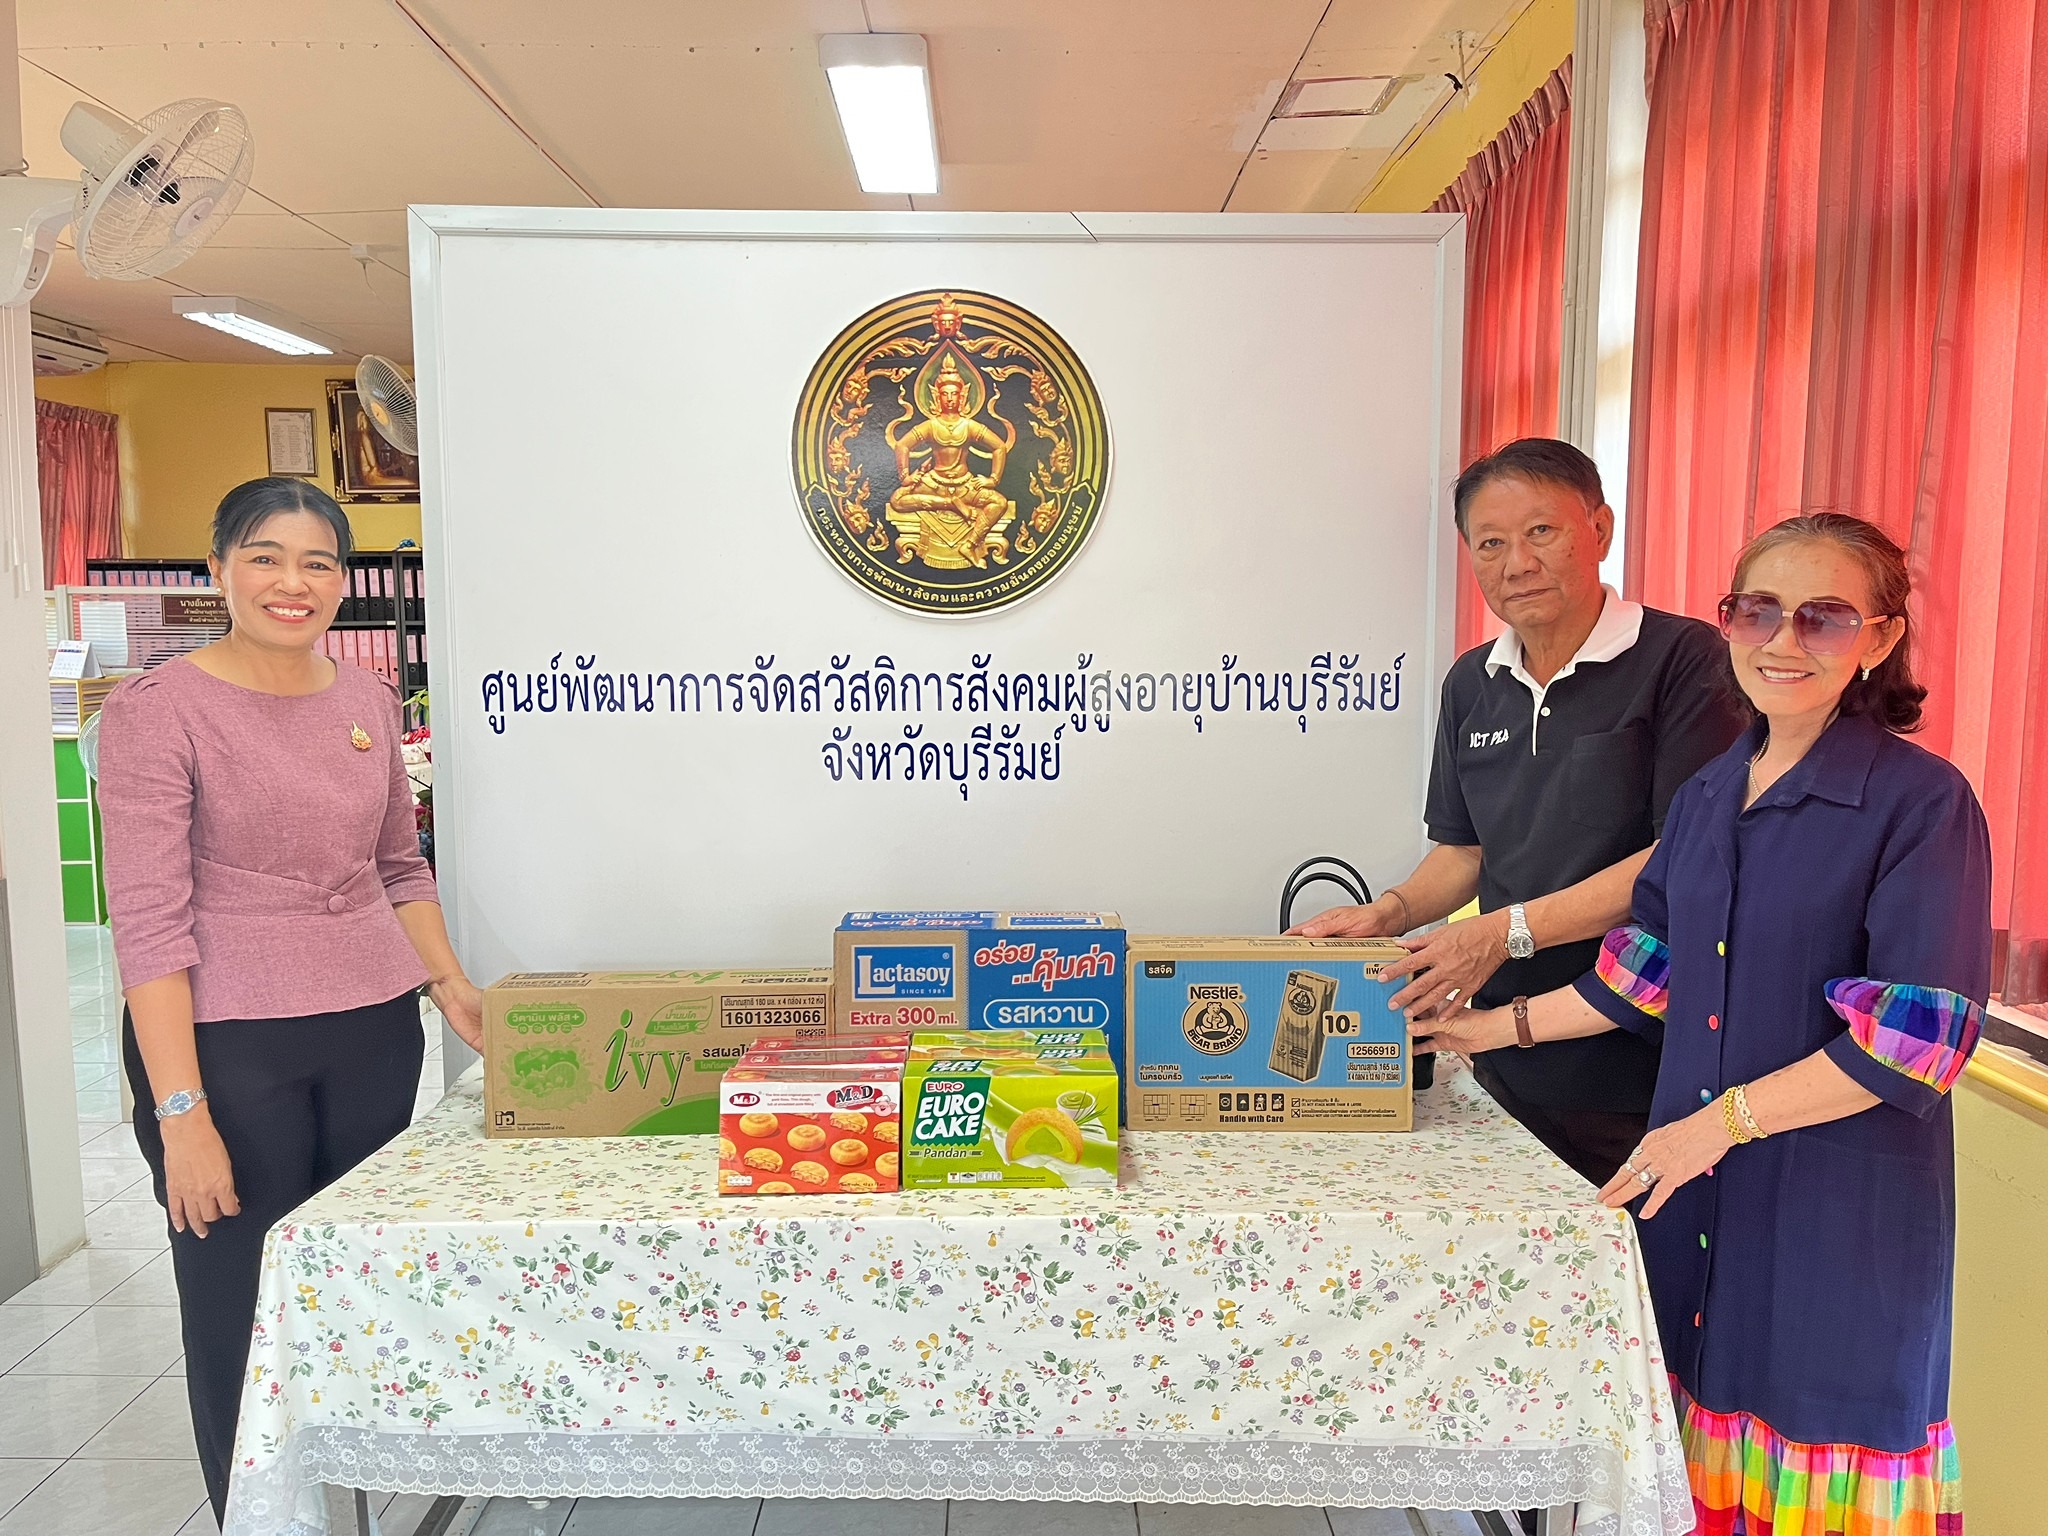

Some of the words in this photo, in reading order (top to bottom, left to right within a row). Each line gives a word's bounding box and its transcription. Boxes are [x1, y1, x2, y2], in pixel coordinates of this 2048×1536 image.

[481, 652, 1406, 735] ศูนย์พัฒนาการจัดสวัสดิการสังคมผู้สูงอายุบ้านบุรีรัมย์
[1469, 732, 1490, 748] ICT
[821, 723, 1066, 801] จังหวัดบุรีรัมย์
[974, 939, 1036, 967] อร่อย
[857, 954, 951, 995] Lactasoy
[1148, 964, 1173, 974] รสจืด
[1366, 963, 1385, 975] แพ็
[808, 997, 815, 1005] 12
[512, 1013, 546, 1022] วิตามิน
[725, 1010, 821, 1025] 1601323066
[850, 1012, 891, 1026] Extra
[897, 1007, 936, 1025] 300
[938, 1011, 958, 1026] ml.
[998, 1004, 1094, 1024] รสหวาน
[1187, 1028, 1211, 1050] BEAR
[1213, 1027, 1243, 1050] BRAND
[603, 1009, 690, 1107] ivy
[1350, 1046, 1396, 1056] 12566918
[1158, 1064, 1179, 1073] ทุกคน
[1379, 1063, 1391, 1071] 165
[1140, 1072, 1183, 1081] ในครอบครัว
[926, 1081, 964, 1092] EURO
[731, 1094, 759, 1105] M&D
[835, 1085, 874, 1104] M&D
[918, 1092, 985, 1119] EURO
[1220, 1115, 1246, 1123] Handle
[1248, 1115, 1264, 1123] with
[1266, 1115, 1284, 1123] Care
[915, 1114, 980, 1140] CAKE
[923, 1147, 968, 1158] Pandan
